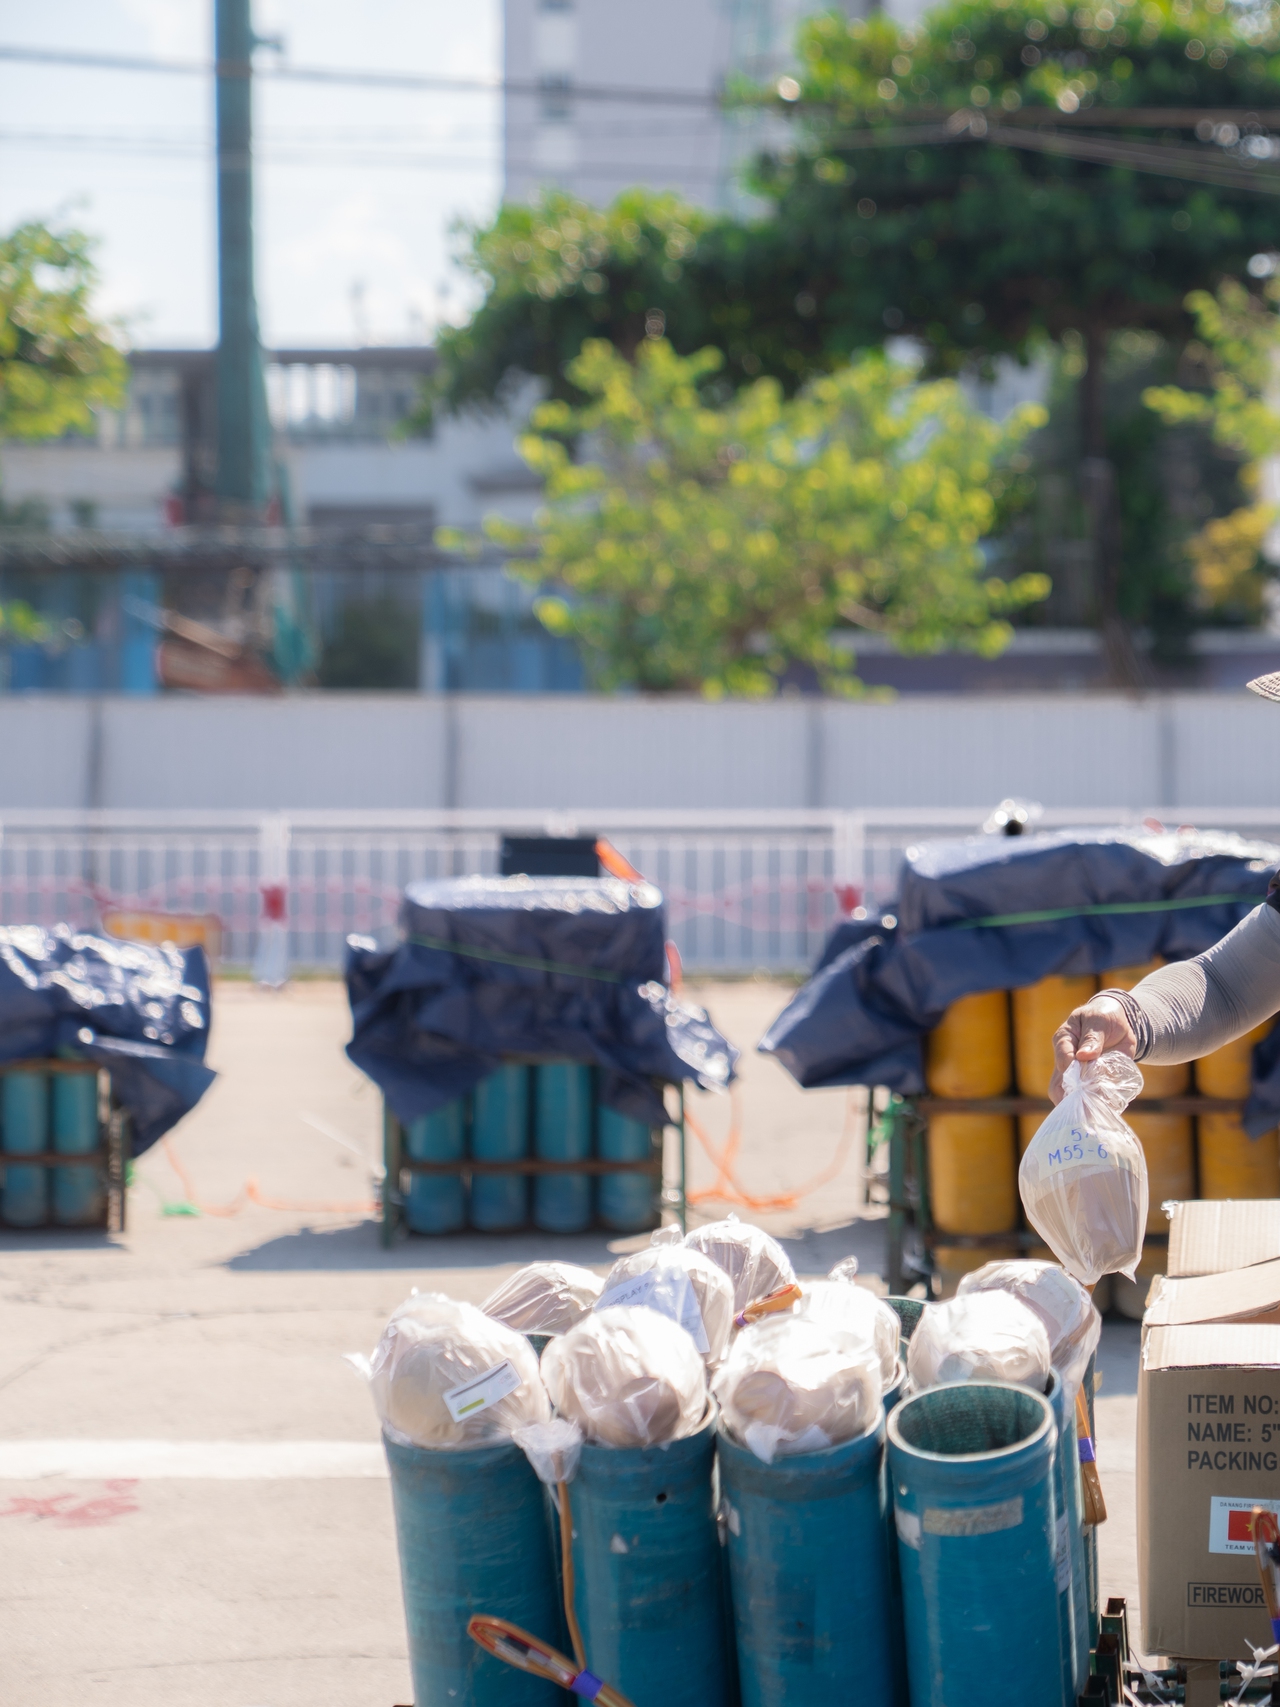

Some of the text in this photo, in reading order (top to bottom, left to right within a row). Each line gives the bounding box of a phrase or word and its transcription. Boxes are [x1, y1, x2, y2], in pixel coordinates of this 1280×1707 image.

[1187, 1394, 1235, 1414] ITEM
[1243, 1395, 1279, 1415] NO:
[1187, 1422, 1280, 1443] NAME: 5"
[1193, 1586, 1265, 1604] FIREWOR
